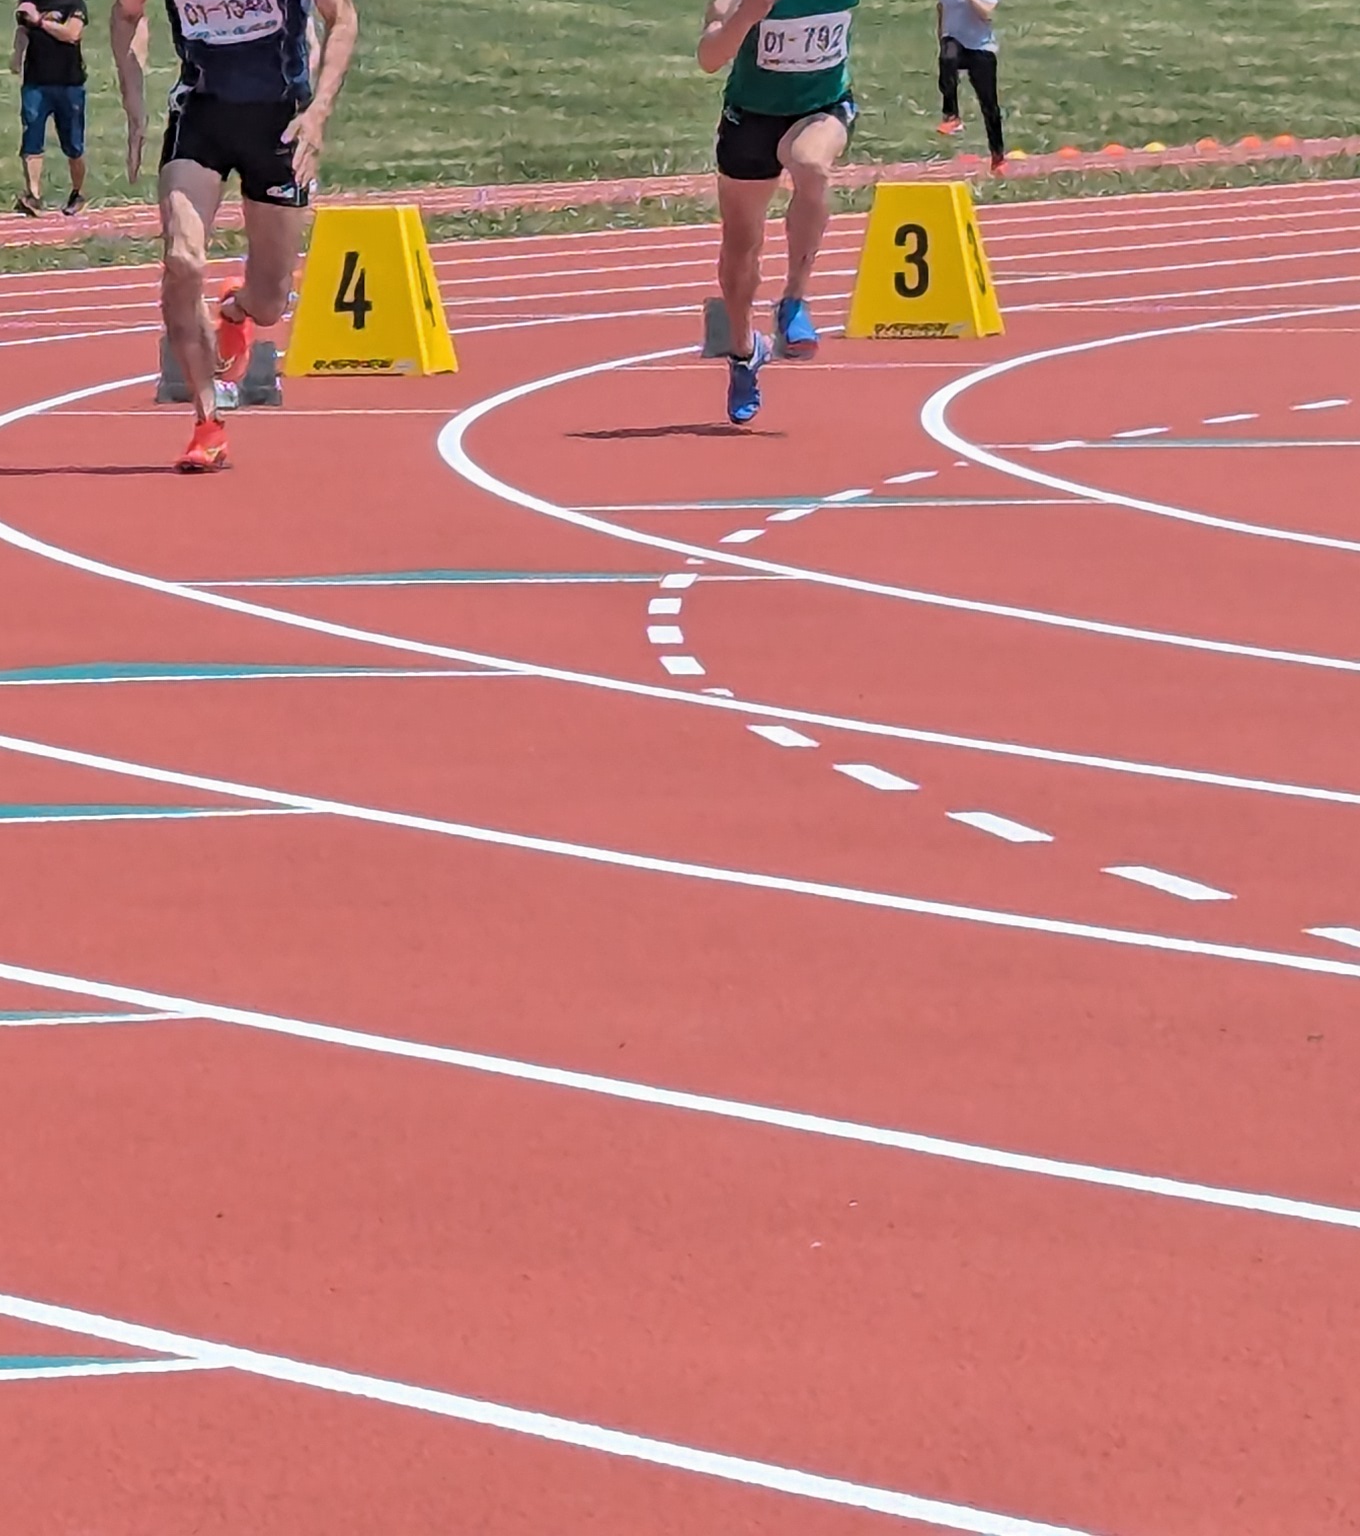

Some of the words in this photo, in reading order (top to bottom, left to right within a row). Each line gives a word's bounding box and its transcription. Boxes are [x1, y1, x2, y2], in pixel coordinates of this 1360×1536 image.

[764, 24, 844, 53] 01-792
[334, 251, 373, 330] 4
[894, 223, 929, 298] 3
